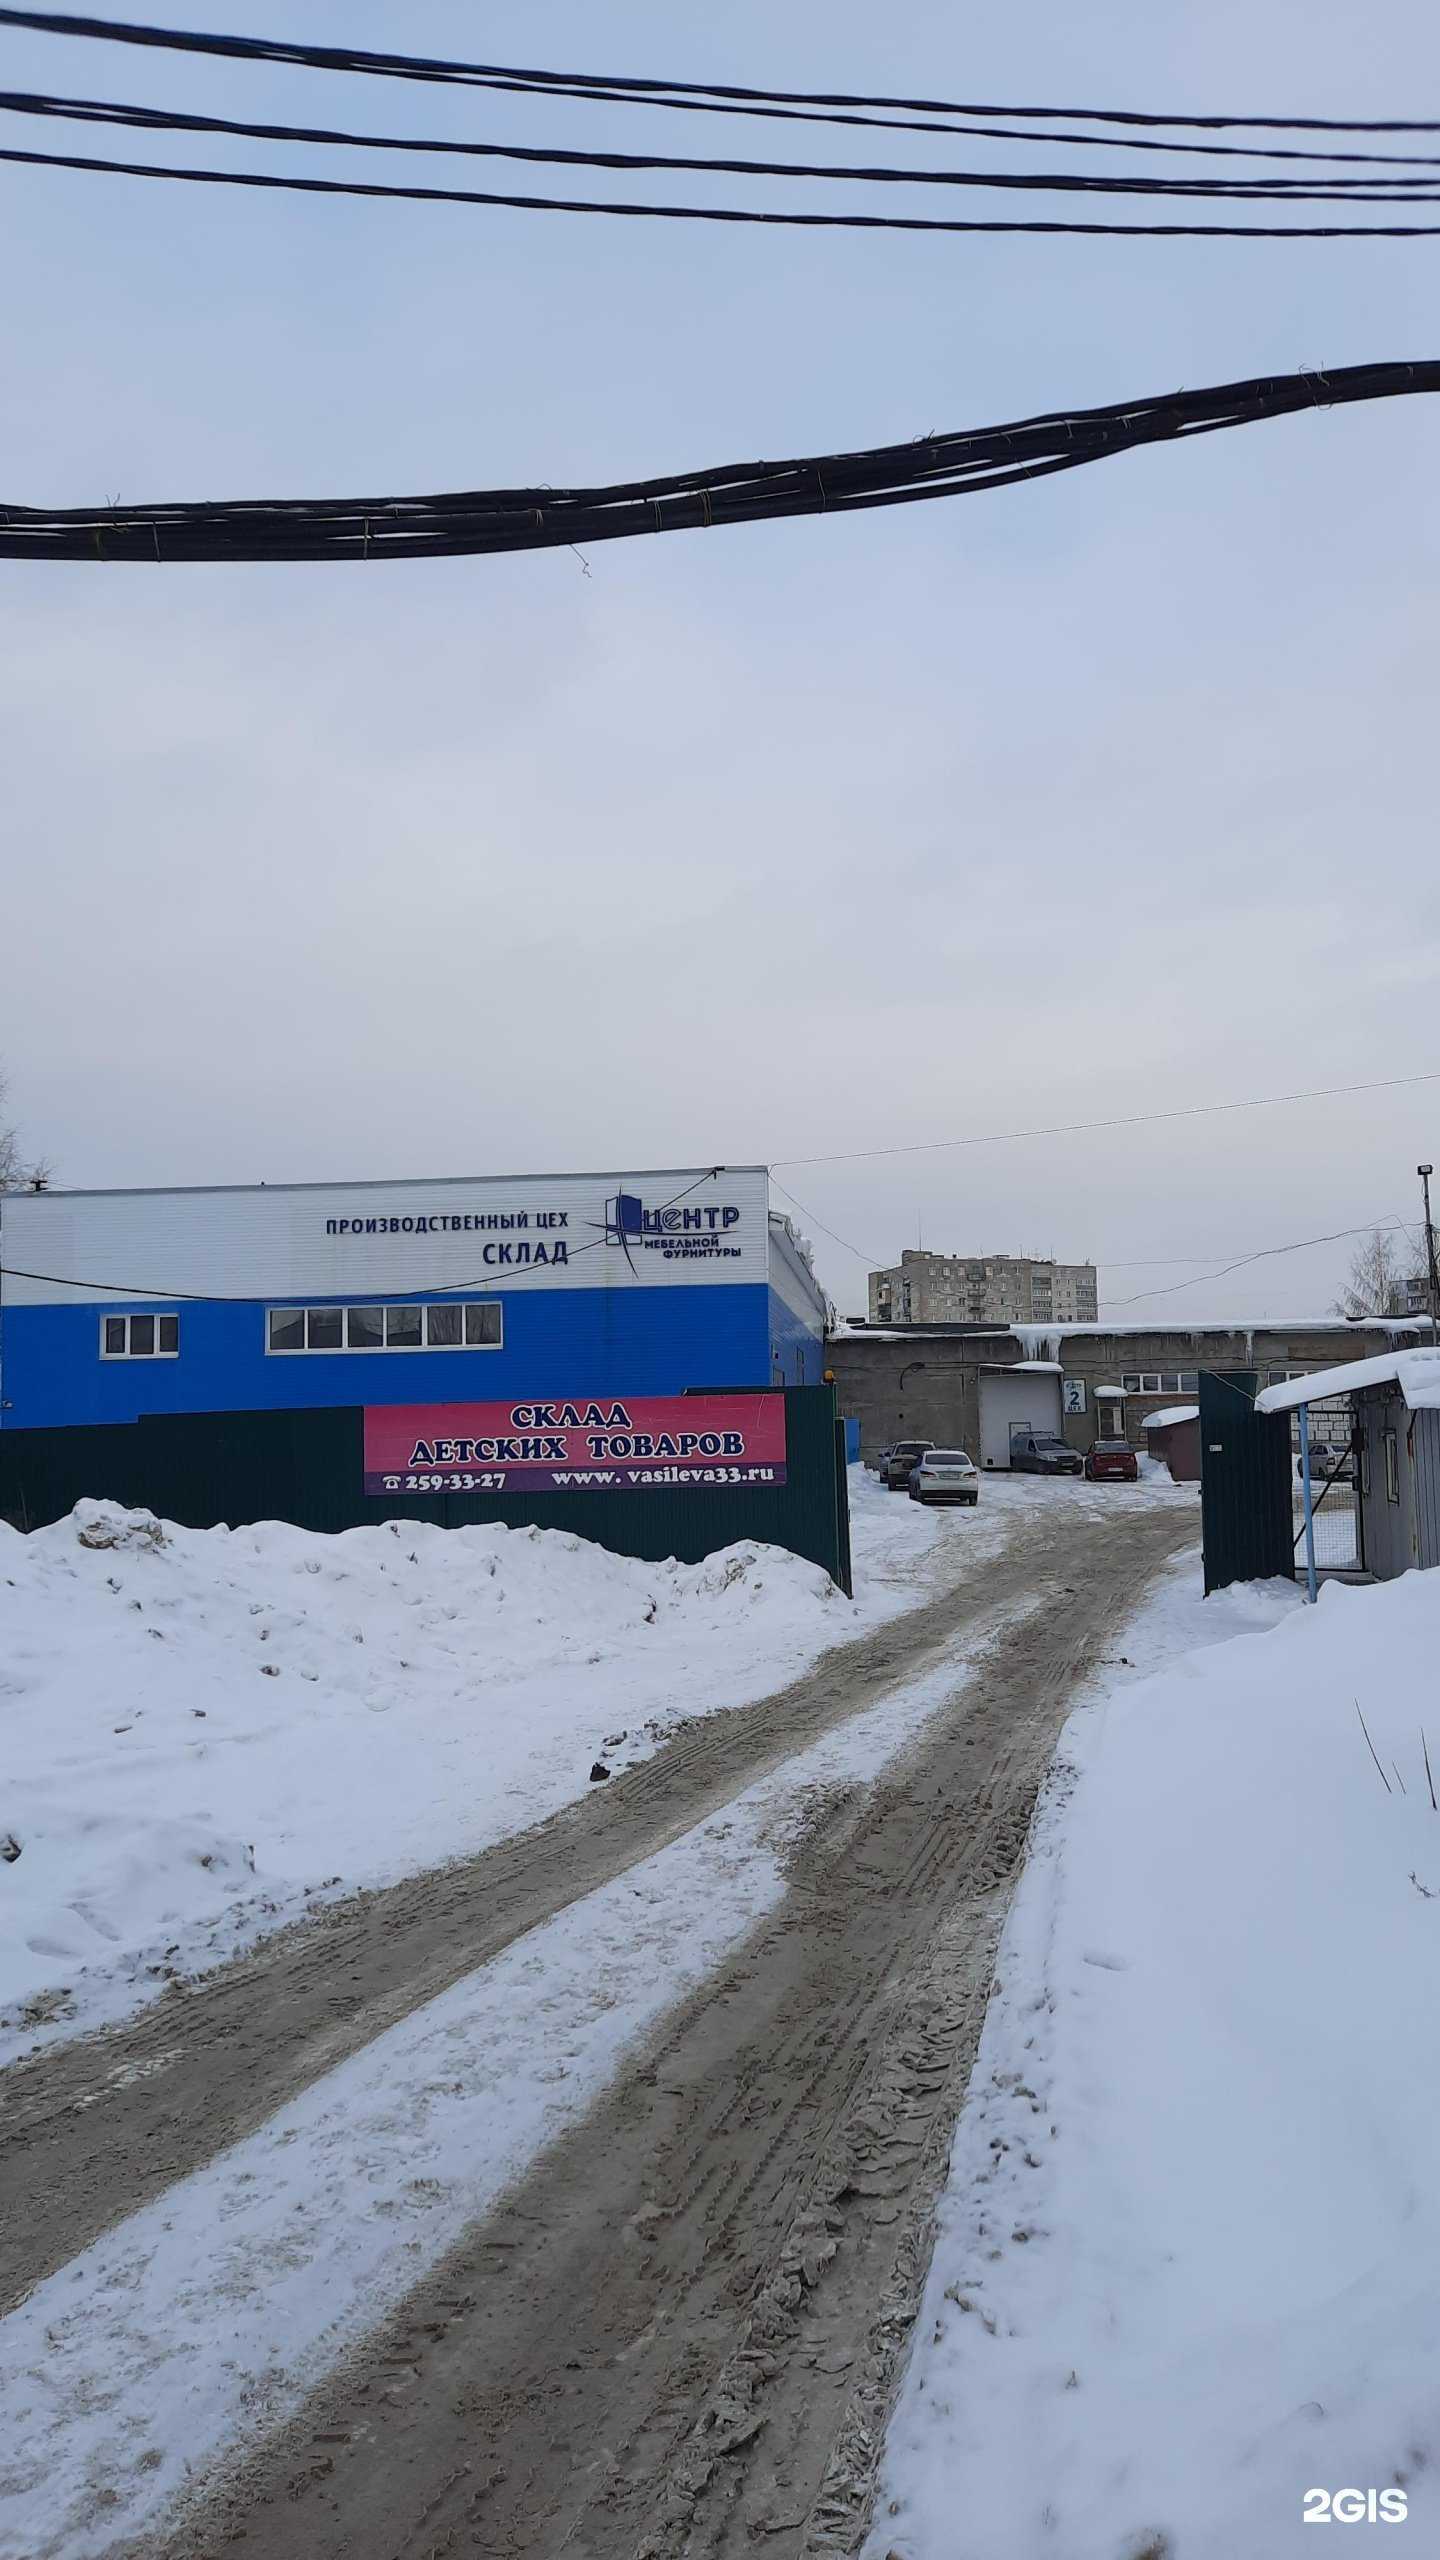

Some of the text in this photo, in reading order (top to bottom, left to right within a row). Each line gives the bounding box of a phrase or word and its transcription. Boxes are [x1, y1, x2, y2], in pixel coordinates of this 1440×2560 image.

[326, 1211, 569, 1234] ПРОИЗВОДСТВЕННЫЙ ЦЕХ
[644, 1234, 720, 1249] МЕБЕЛЬНОЙ
[482, 1241, 569, 1265] СКЛАД
[662, 1247, 742, 1259] ФУРНИТУРЫ
[1070, 1391, 1080, 1406] 2
[511, 1402, 633, 1430] СКЛАД
[408, 1431, 745, 1468] ДЕТСКИХ ТОВАРОВ
[405, 1473, 506, 1491] 259-33-27
[627, 1465, 775, 1484] vasileva33.ru
